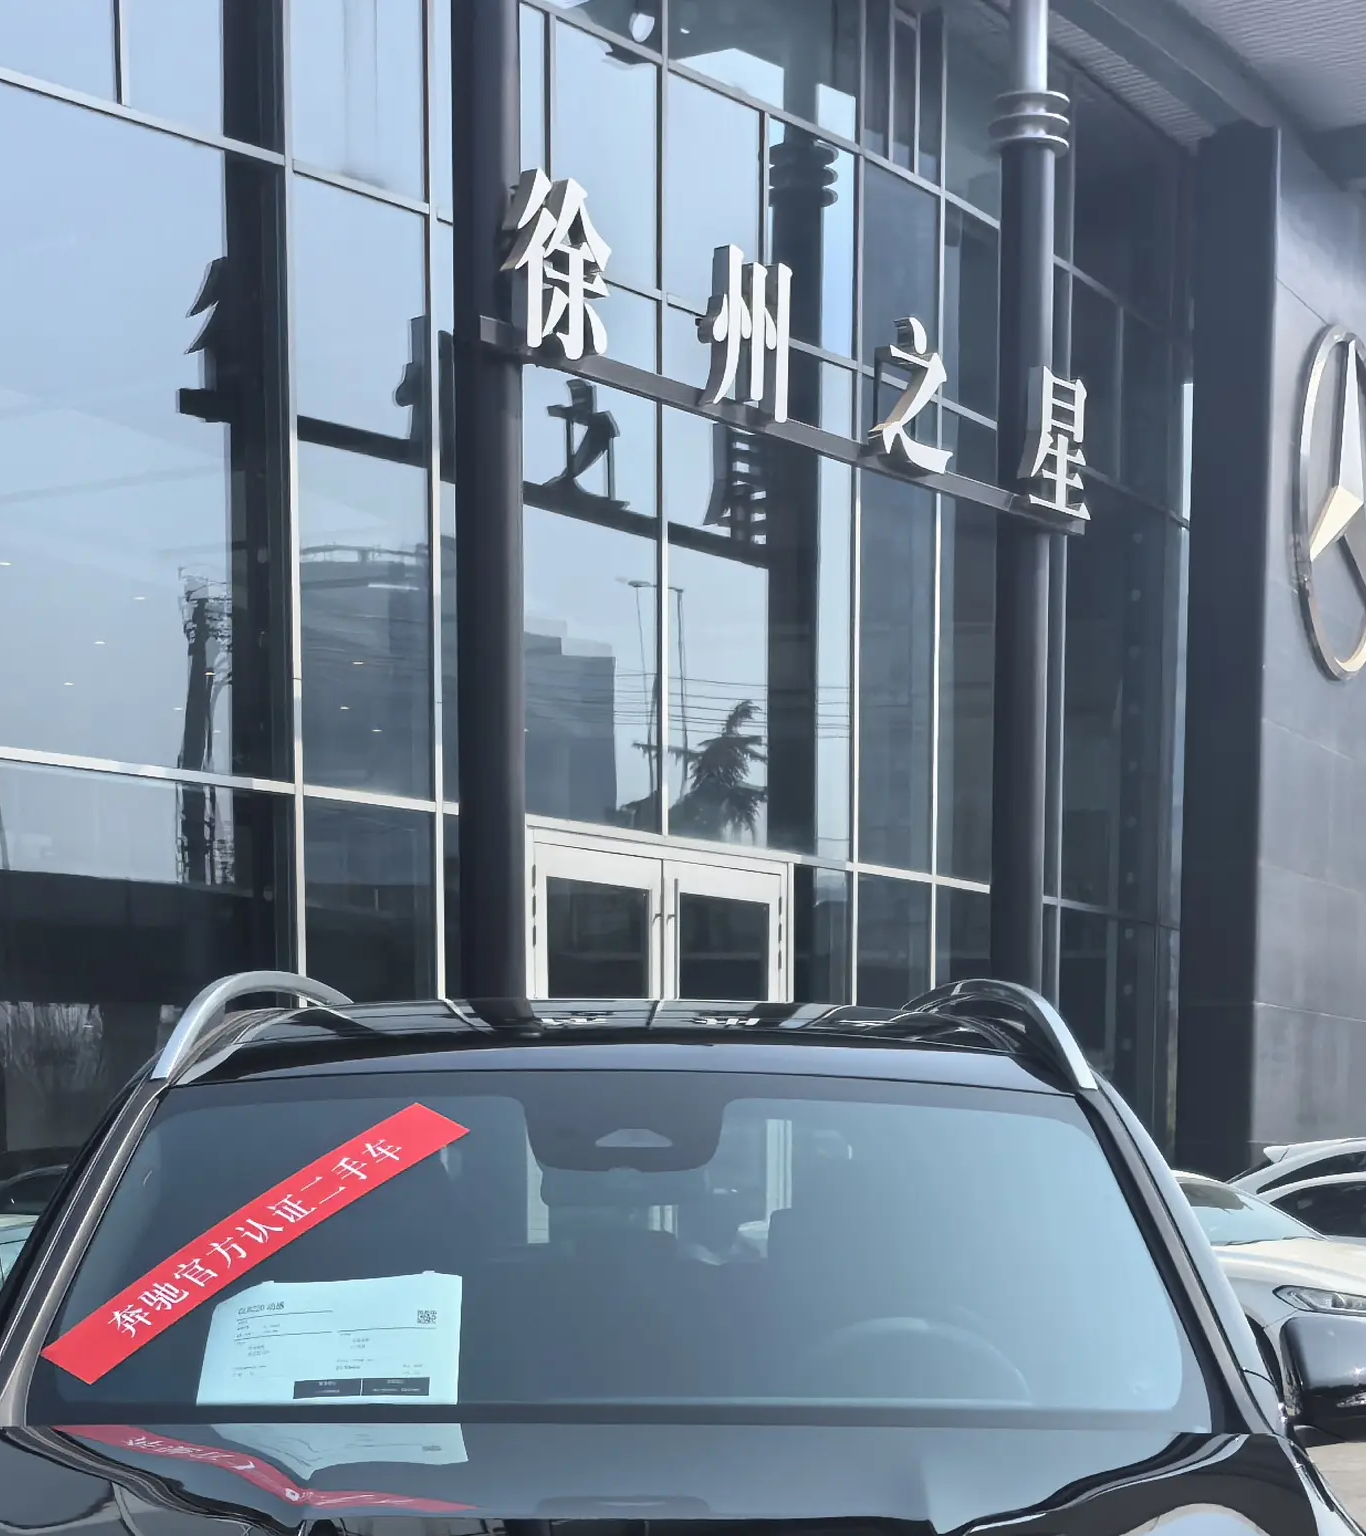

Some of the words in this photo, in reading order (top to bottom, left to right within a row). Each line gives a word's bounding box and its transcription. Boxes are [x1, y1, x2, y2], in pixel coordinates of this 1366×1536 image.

[503, 168, 1091, 520] 徐州之星
[107, 1138, 403, 1339] 奔驰官方认证二手车
